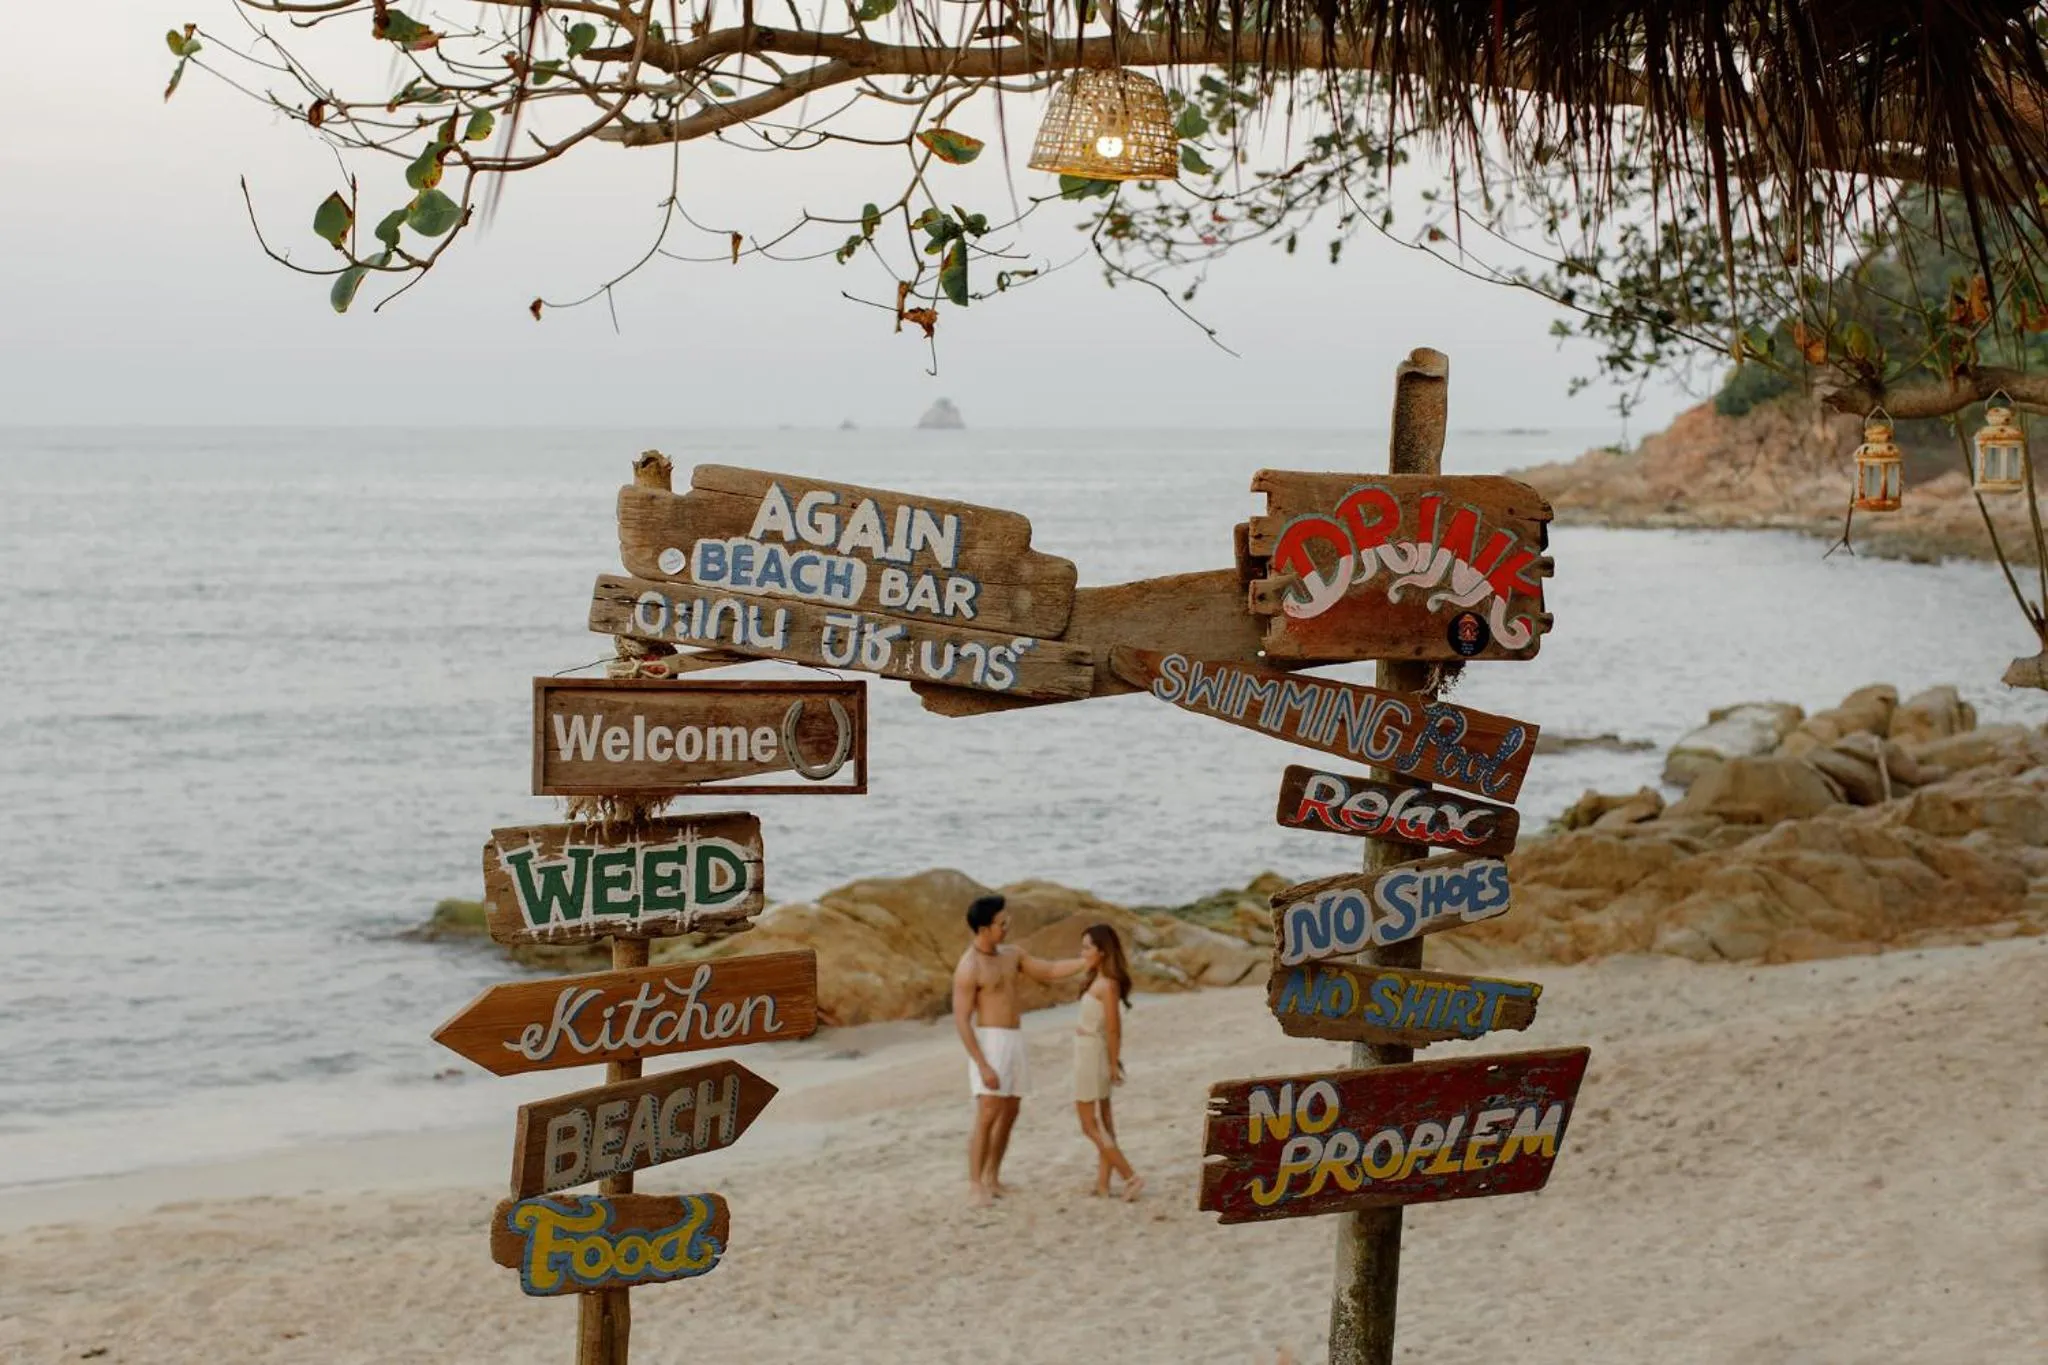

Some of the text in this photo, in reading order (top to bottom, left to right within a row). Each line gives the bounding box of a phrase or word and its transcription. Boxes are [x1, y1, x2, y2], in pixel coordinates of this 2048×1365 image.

[749, 482, 960, 569] AGAIN
[1273, 484, 1543, 650] DRINK
[692, 538, 980, 620] BEACH BAR
[920, 637, 1039, 691] บาร์
[552, 714, 778, 763] Welcome
[1153, 653, 1526, 795] SWIMMING Pool
[1285, 773, 1496, 846] Relax
[503, 838, 752, 930] WEED
[1282, 858, 1511, 966] NO SHOES
[503, 964, 783, 1061] Kitchen
[1278, 967, 1543, 1035] NO SHIRT
[542, 1074, 740, 1194] BEACH
[1243, 1104, 1565, 1207] PROPLEM
[1247, 1080, 1341, 1146] NO
[510, 1198, 722, 1293] Food
